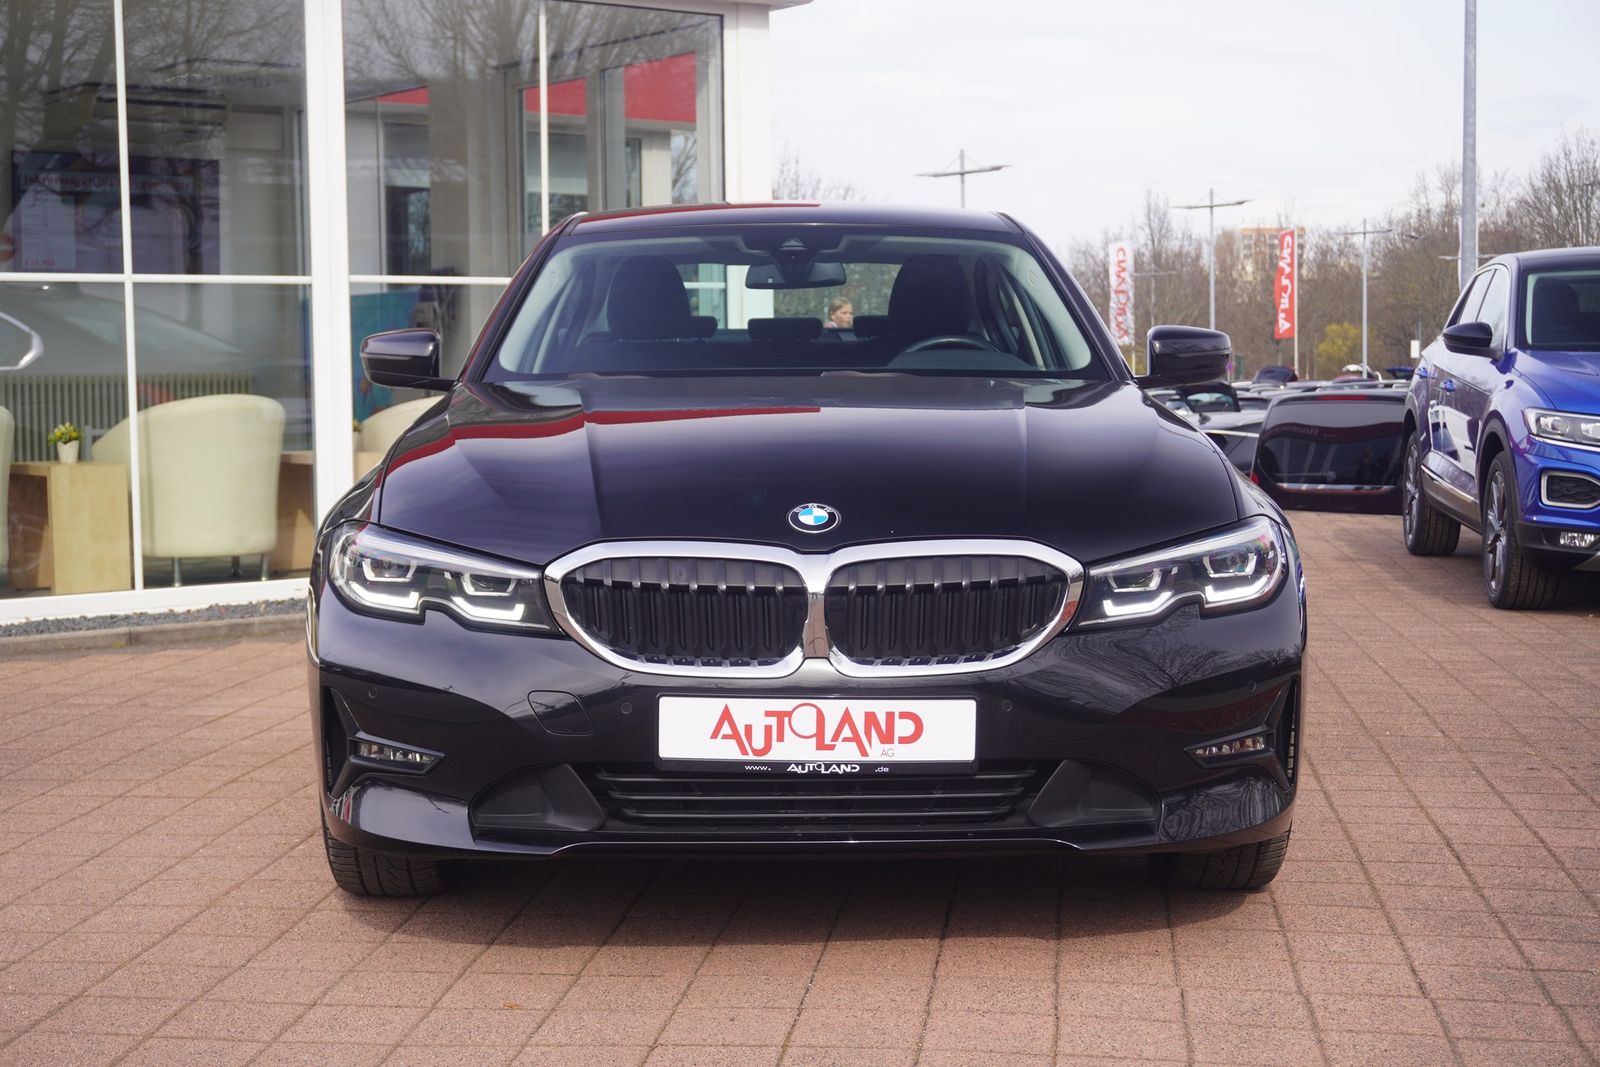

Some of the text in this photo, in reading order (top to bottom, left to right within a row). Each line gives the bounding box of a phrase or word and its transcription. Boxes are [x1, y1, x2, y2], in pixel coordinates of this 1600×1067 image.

[710, 703, 924, 757] AUTOLAND
[880, 749, 895, 757] AG
[787, 761, 860, 774] AUTOLAND
